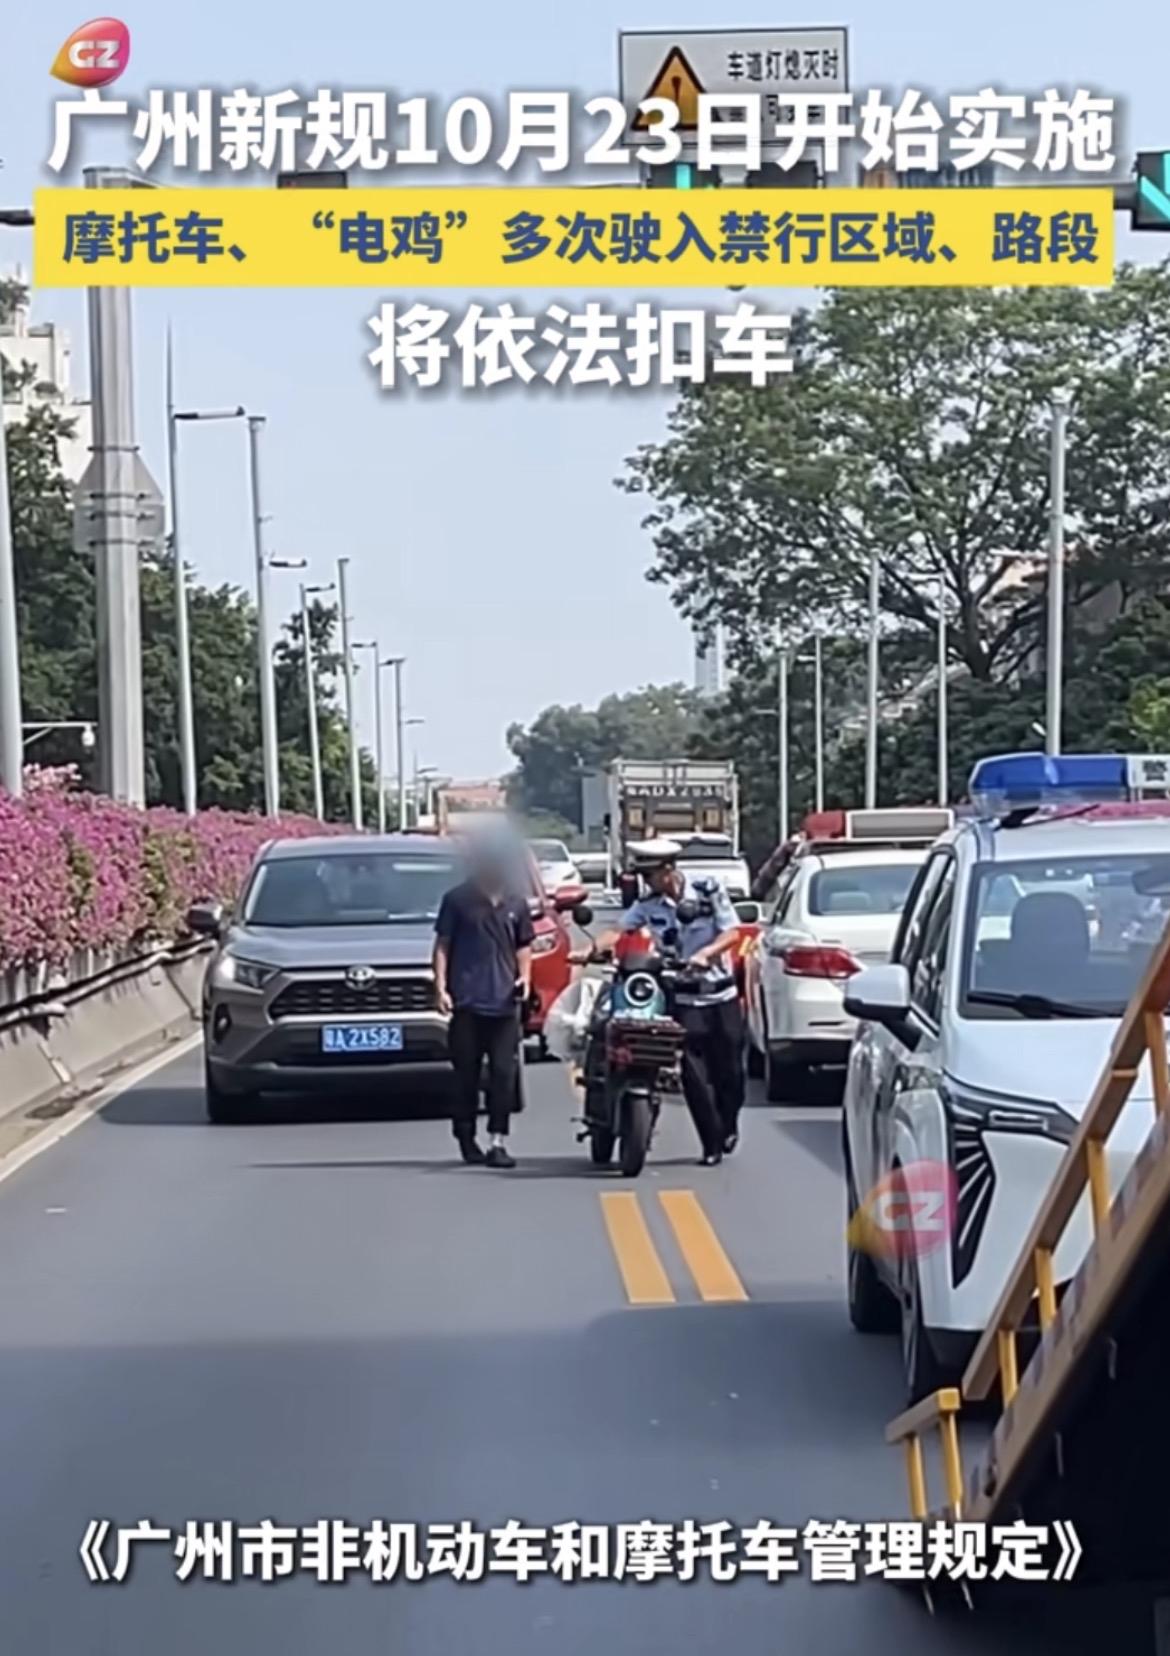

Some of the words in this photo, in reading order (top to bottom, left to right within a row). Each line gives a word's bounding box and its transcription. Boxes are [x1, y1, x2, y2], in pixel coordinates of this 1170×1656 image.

[727, 48, 839, 82] 车道灯熄灭时
